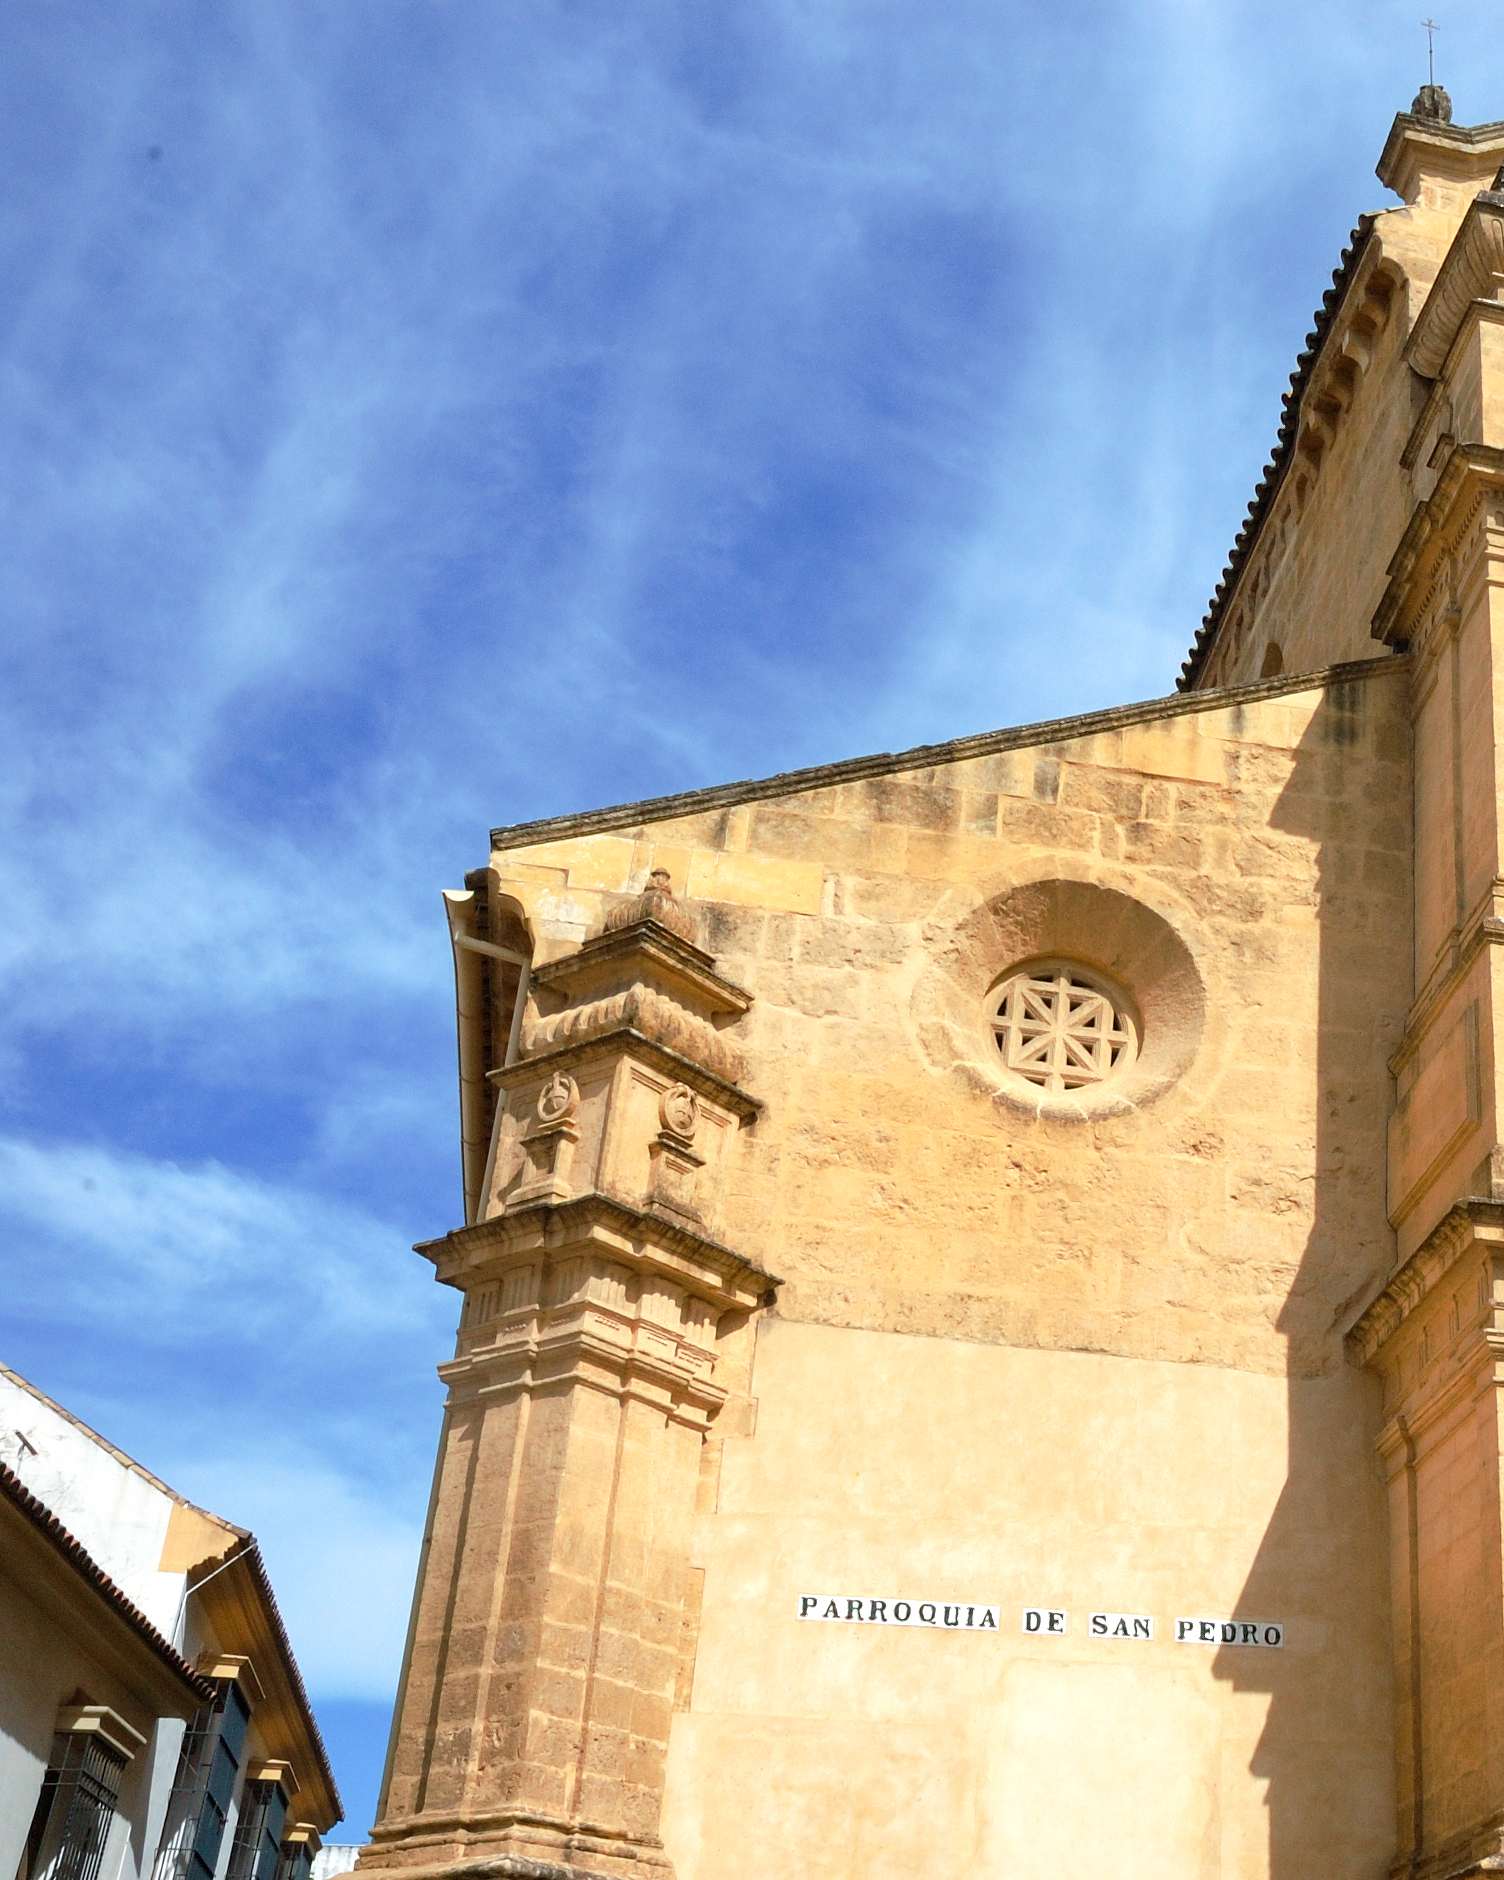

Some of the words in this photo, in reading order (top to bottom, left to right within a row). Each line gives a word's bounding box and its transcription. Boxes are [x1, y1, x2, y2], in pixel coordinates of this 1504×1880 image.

[800, 1597, 996, 1627] PARROQUIA
[1025, 1611, 1064, 1633] DE
[1092, 1615, 1150, 1638] SAN
[1177, 1620, 1281, 1645] PEDRO
